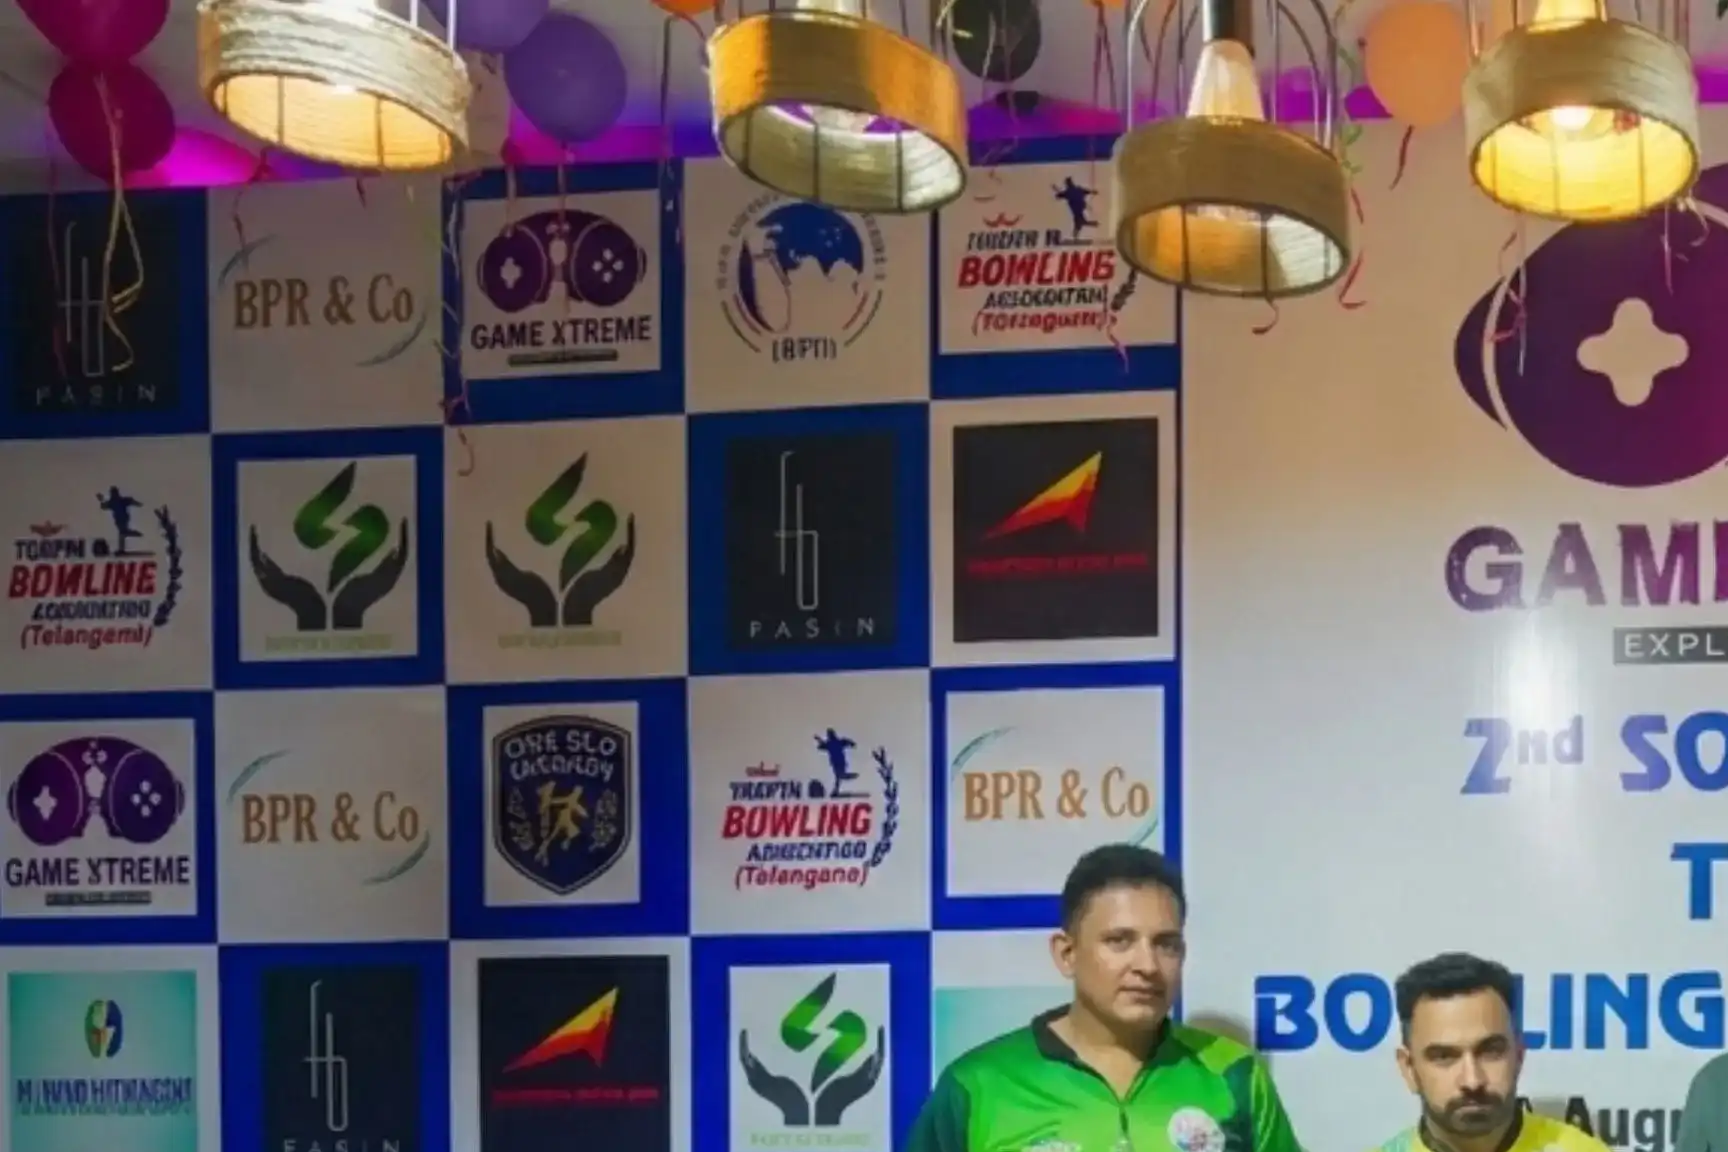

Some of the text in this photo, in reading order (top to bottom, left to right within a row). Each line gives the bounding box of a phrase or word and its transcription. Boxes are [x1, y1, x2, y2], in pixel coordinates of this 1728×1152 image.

[233, 274, 414, 330] BPR & Co
[471, 315, 652, 350] GAME XTREME
[1460, 712, 1584, 795] 2nd
[242, 791, 419, 844] BPR & Co
[963, 766, 1150, 821] BPR & Co
[723, 804, 873, 839] BOWLING
[5, 856, 191, 886] GAME XTREME
[1253, 971, 1726, 1053] BOLING
